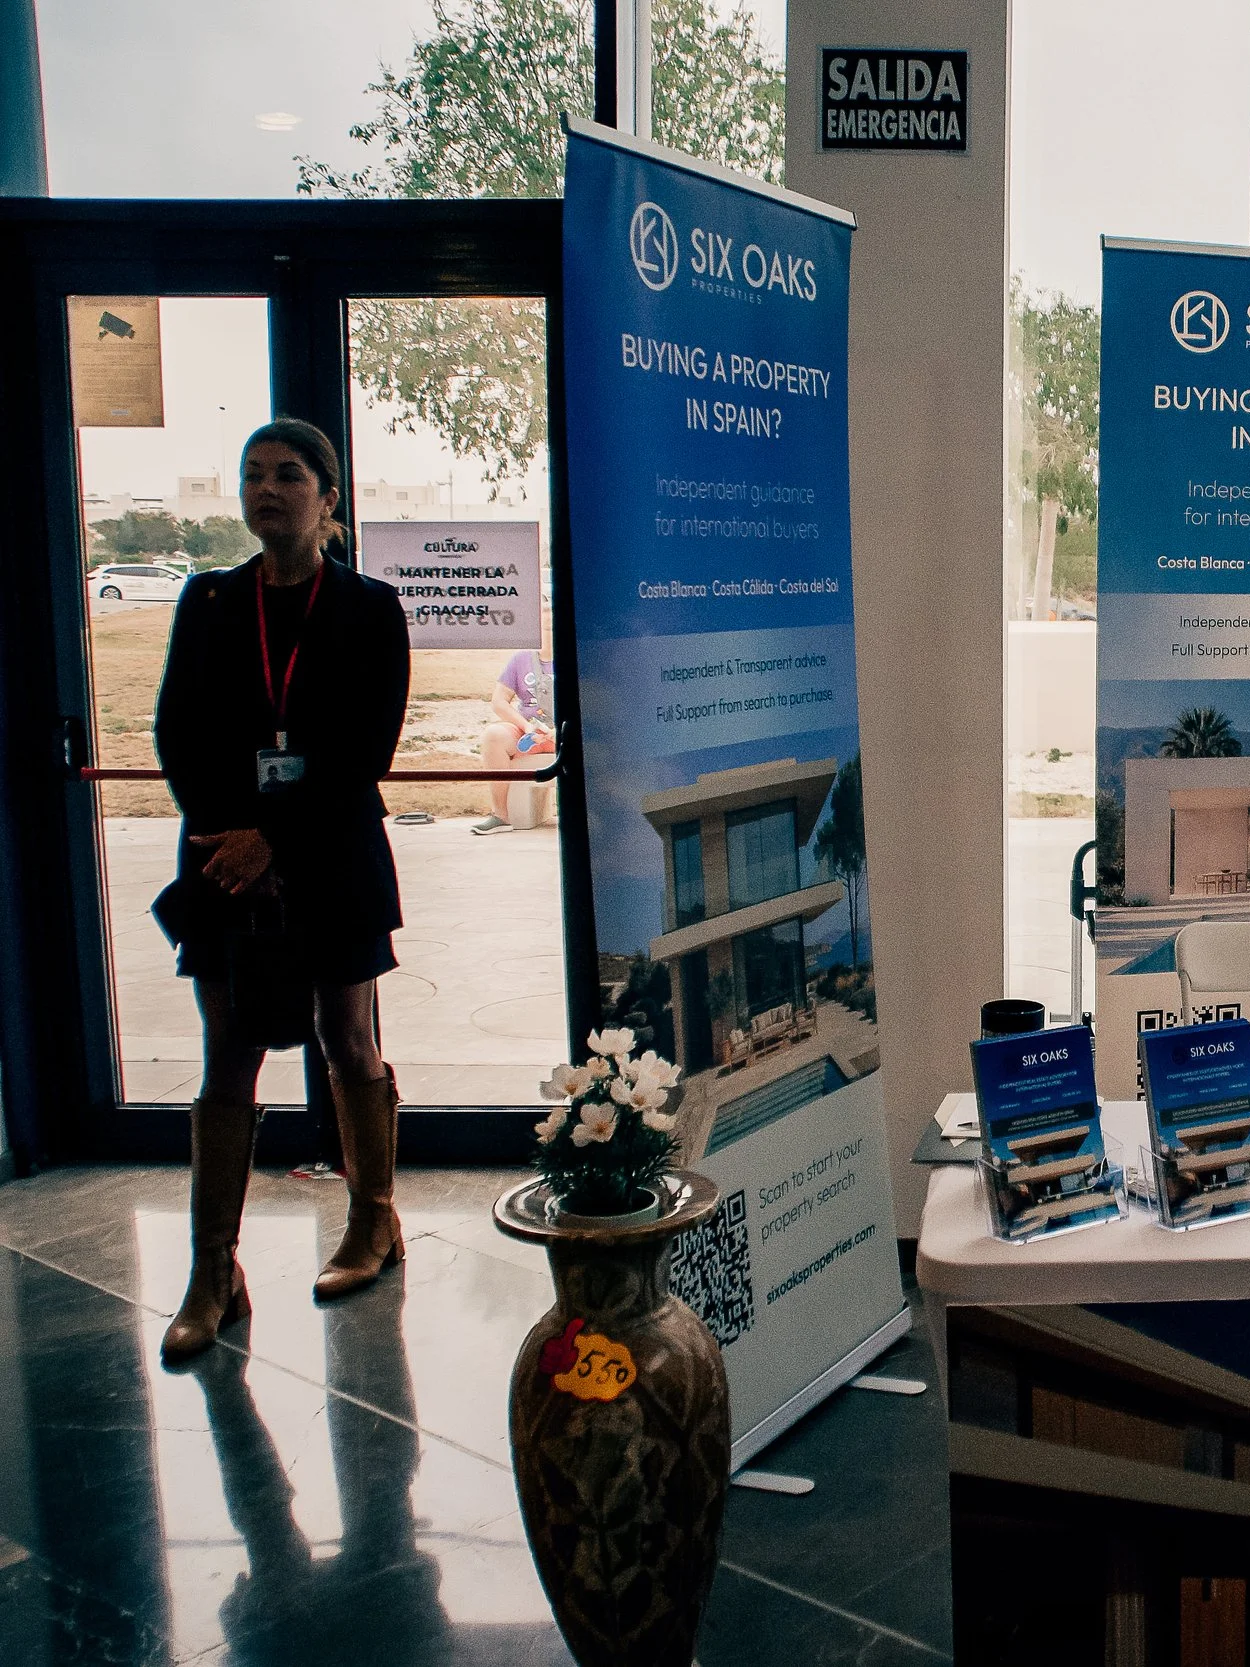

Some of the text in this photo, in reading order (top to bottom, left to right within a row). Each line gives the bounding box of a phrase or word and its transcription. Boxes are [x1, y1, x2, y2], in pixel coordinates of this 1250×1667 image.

[828, 57, 961, 102] SALIDA
[827, 109, 961, 141] EMERGENCIA
[691, 228, 817, 301] SIX OAKS
[691, 278, 762, 305] PROPERTIES
[622, 333, 831, 398] BUYING A PROPERTY
[687, 398, 782, 438] IN SPAIN?
[656, 474, 815, 507] Independent guidance
[655, 511, 819, 544] for international buyers
[1184, 507, 1211, 526] for
[424, 542, 477, 552] CULTURA
[1157, 556, 1197, 569] Costa
[1200, 556, 1244, 570] Blanca
[400, 567, 481, 578] MANTENER
[485, 567, 504, 578] LA
[638, 577, 839, 599] Costa Blanca Costa Cálida Costa del Sol
[395, 586, 518, 597] UERTA CERRADA
[416, 605, 489, 617] ¡GRACIAS!
[1171, 643, 1194, 656] Full
[1197, 643, 1249, 659] Support
[660, 652, 827, 684] Independent & Transparent advice
[656, 688, 833, 725] Full Support from search to purchase
[1022, 1054, 1037, 1067] SIX
[1039, 1048, 1069, 1063] OAKS
[1190, 1046, 1205, 1058] SIX
[1207, 1041, 1235, 1055] OAKS
[759, 1138, 863, 1209] Scan to start your
[761, 1169, 856, 1246] property search
[766, 1223, 876, 1306] sixoaksproperties.com
